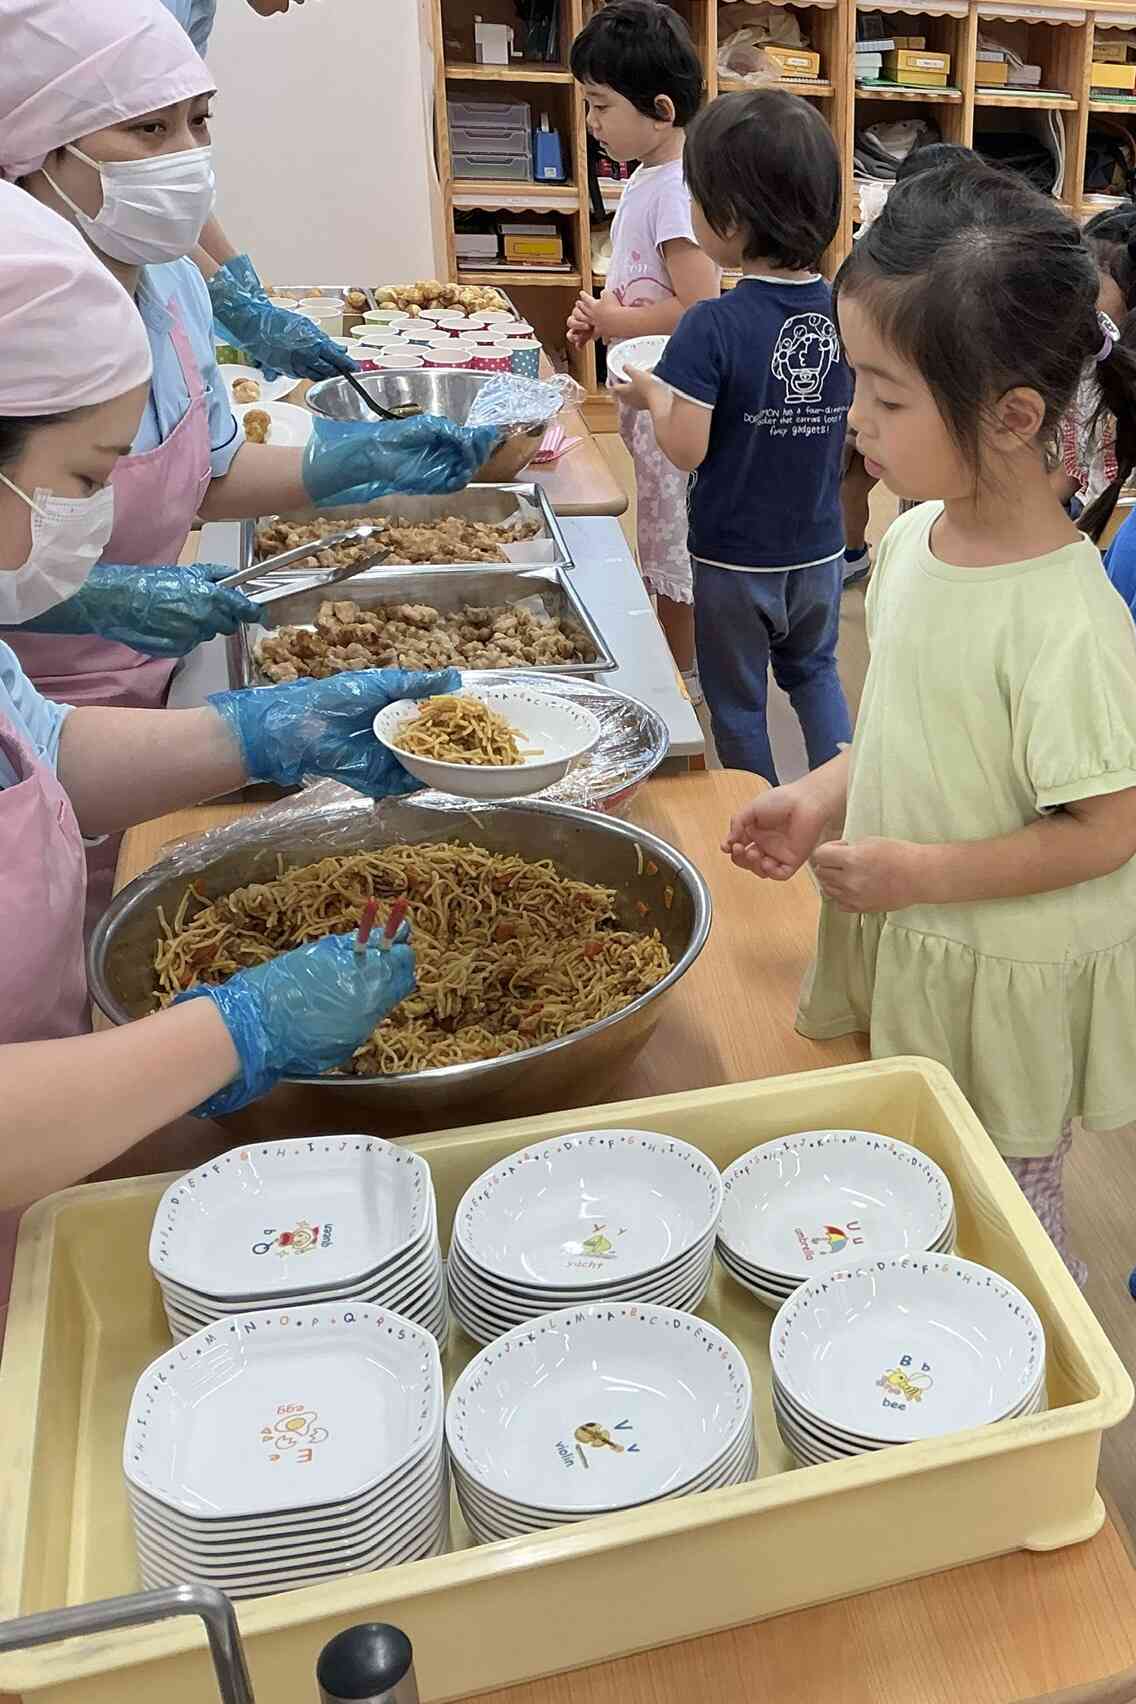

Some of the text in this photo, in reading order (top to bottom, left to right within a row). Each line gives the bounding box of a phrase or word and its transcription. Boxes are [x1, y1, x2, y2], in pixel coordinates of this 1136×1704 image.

[846, 1221, 861, 1231] U
[252, 1239, 276, 1255] Q
[900, 1355, 930, 1371] B b
[882, 1397, 906, 1411] bee
[614, 1419, 633, 1430] V
[296, 1448, 312, 1463] E
[555, 1441, 575, 1468] violin
